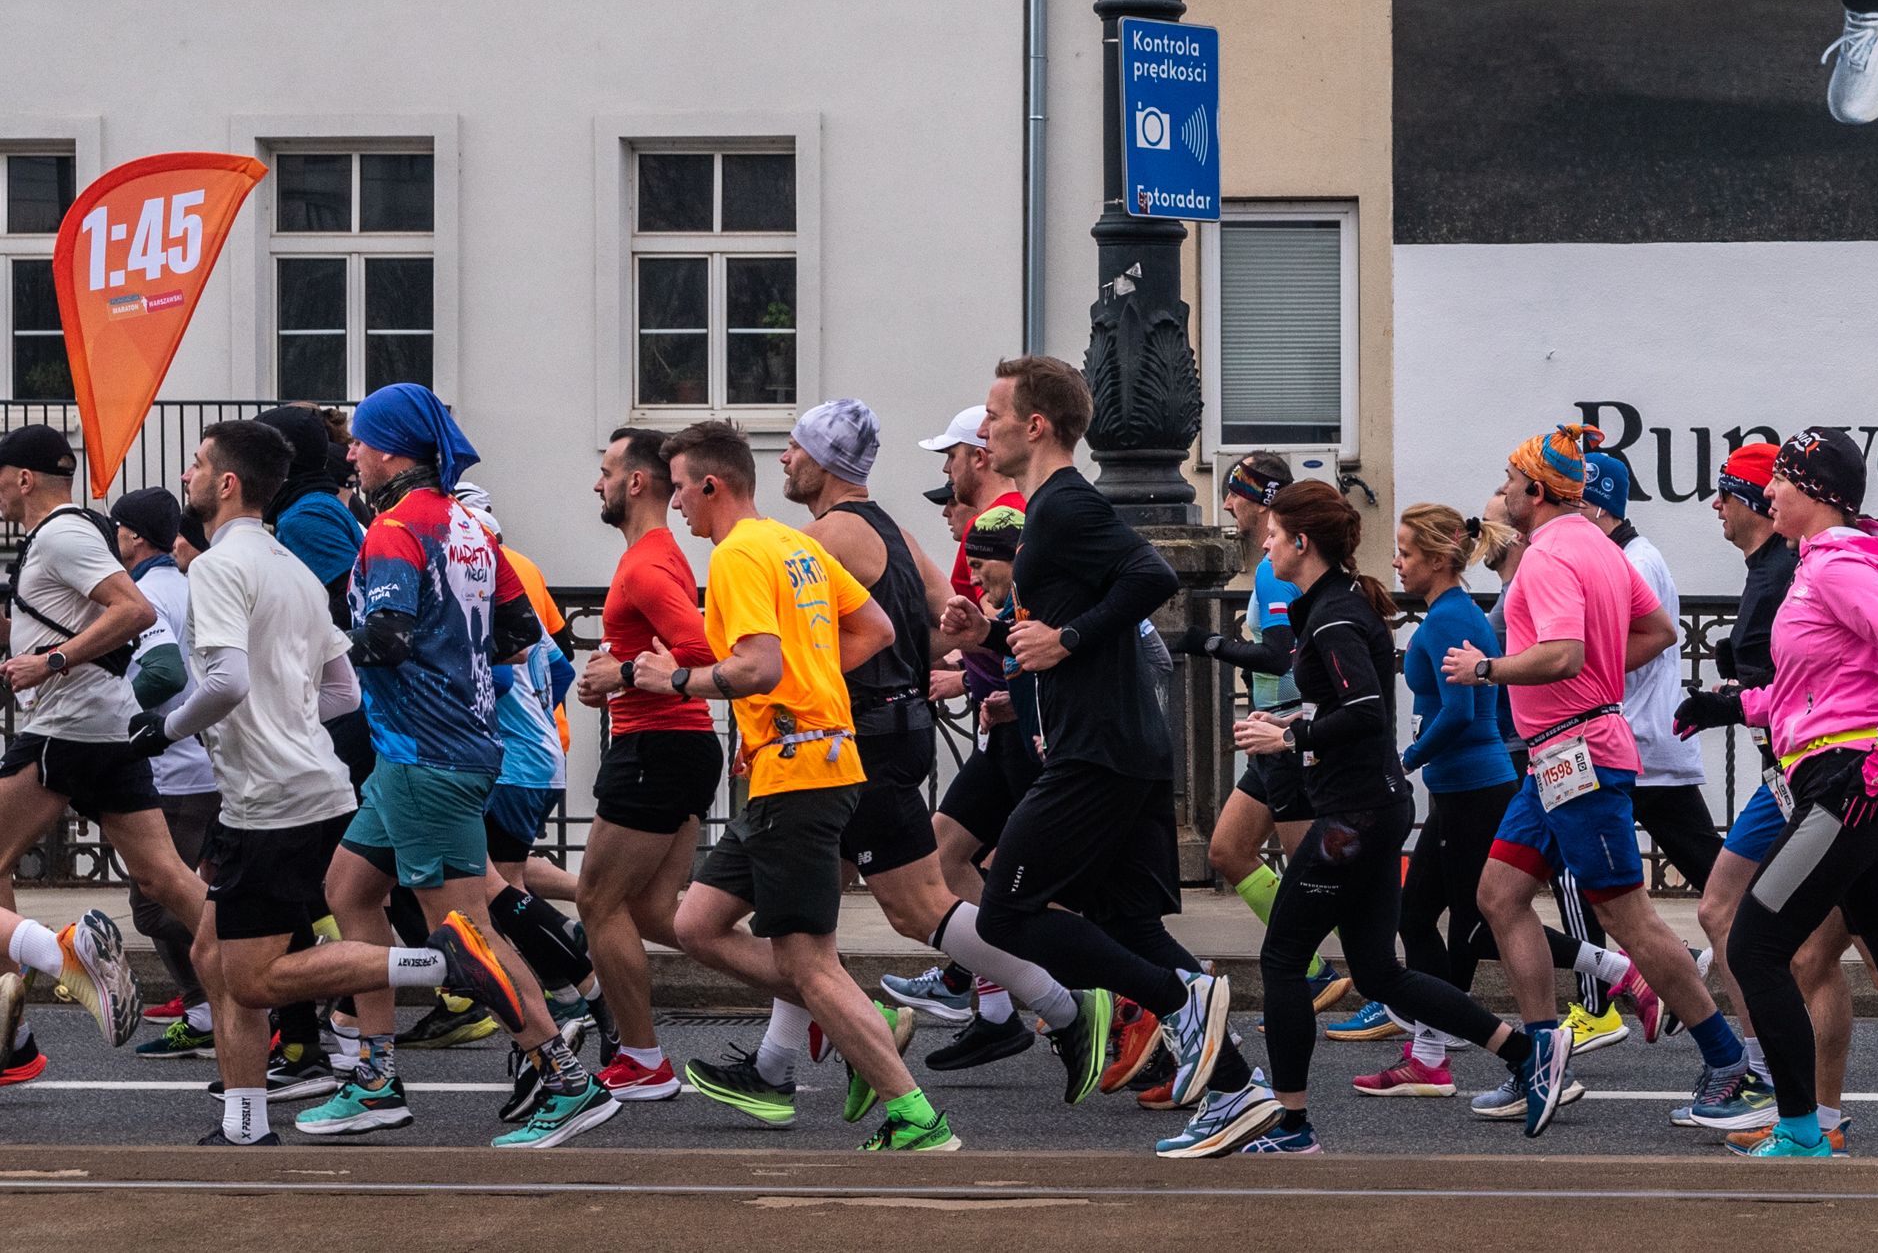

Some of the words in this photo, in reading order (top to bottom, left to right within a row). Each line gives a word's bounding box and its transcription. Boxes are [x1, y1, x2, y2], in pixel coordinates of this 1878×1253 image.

[1133, 30, 1200, 57] Kontrola
[1133, 59, 1208, 83] prędkości
[82, 188, 205, 291] 1:45
[1011, 865, 1025, 892] KIPSTA
